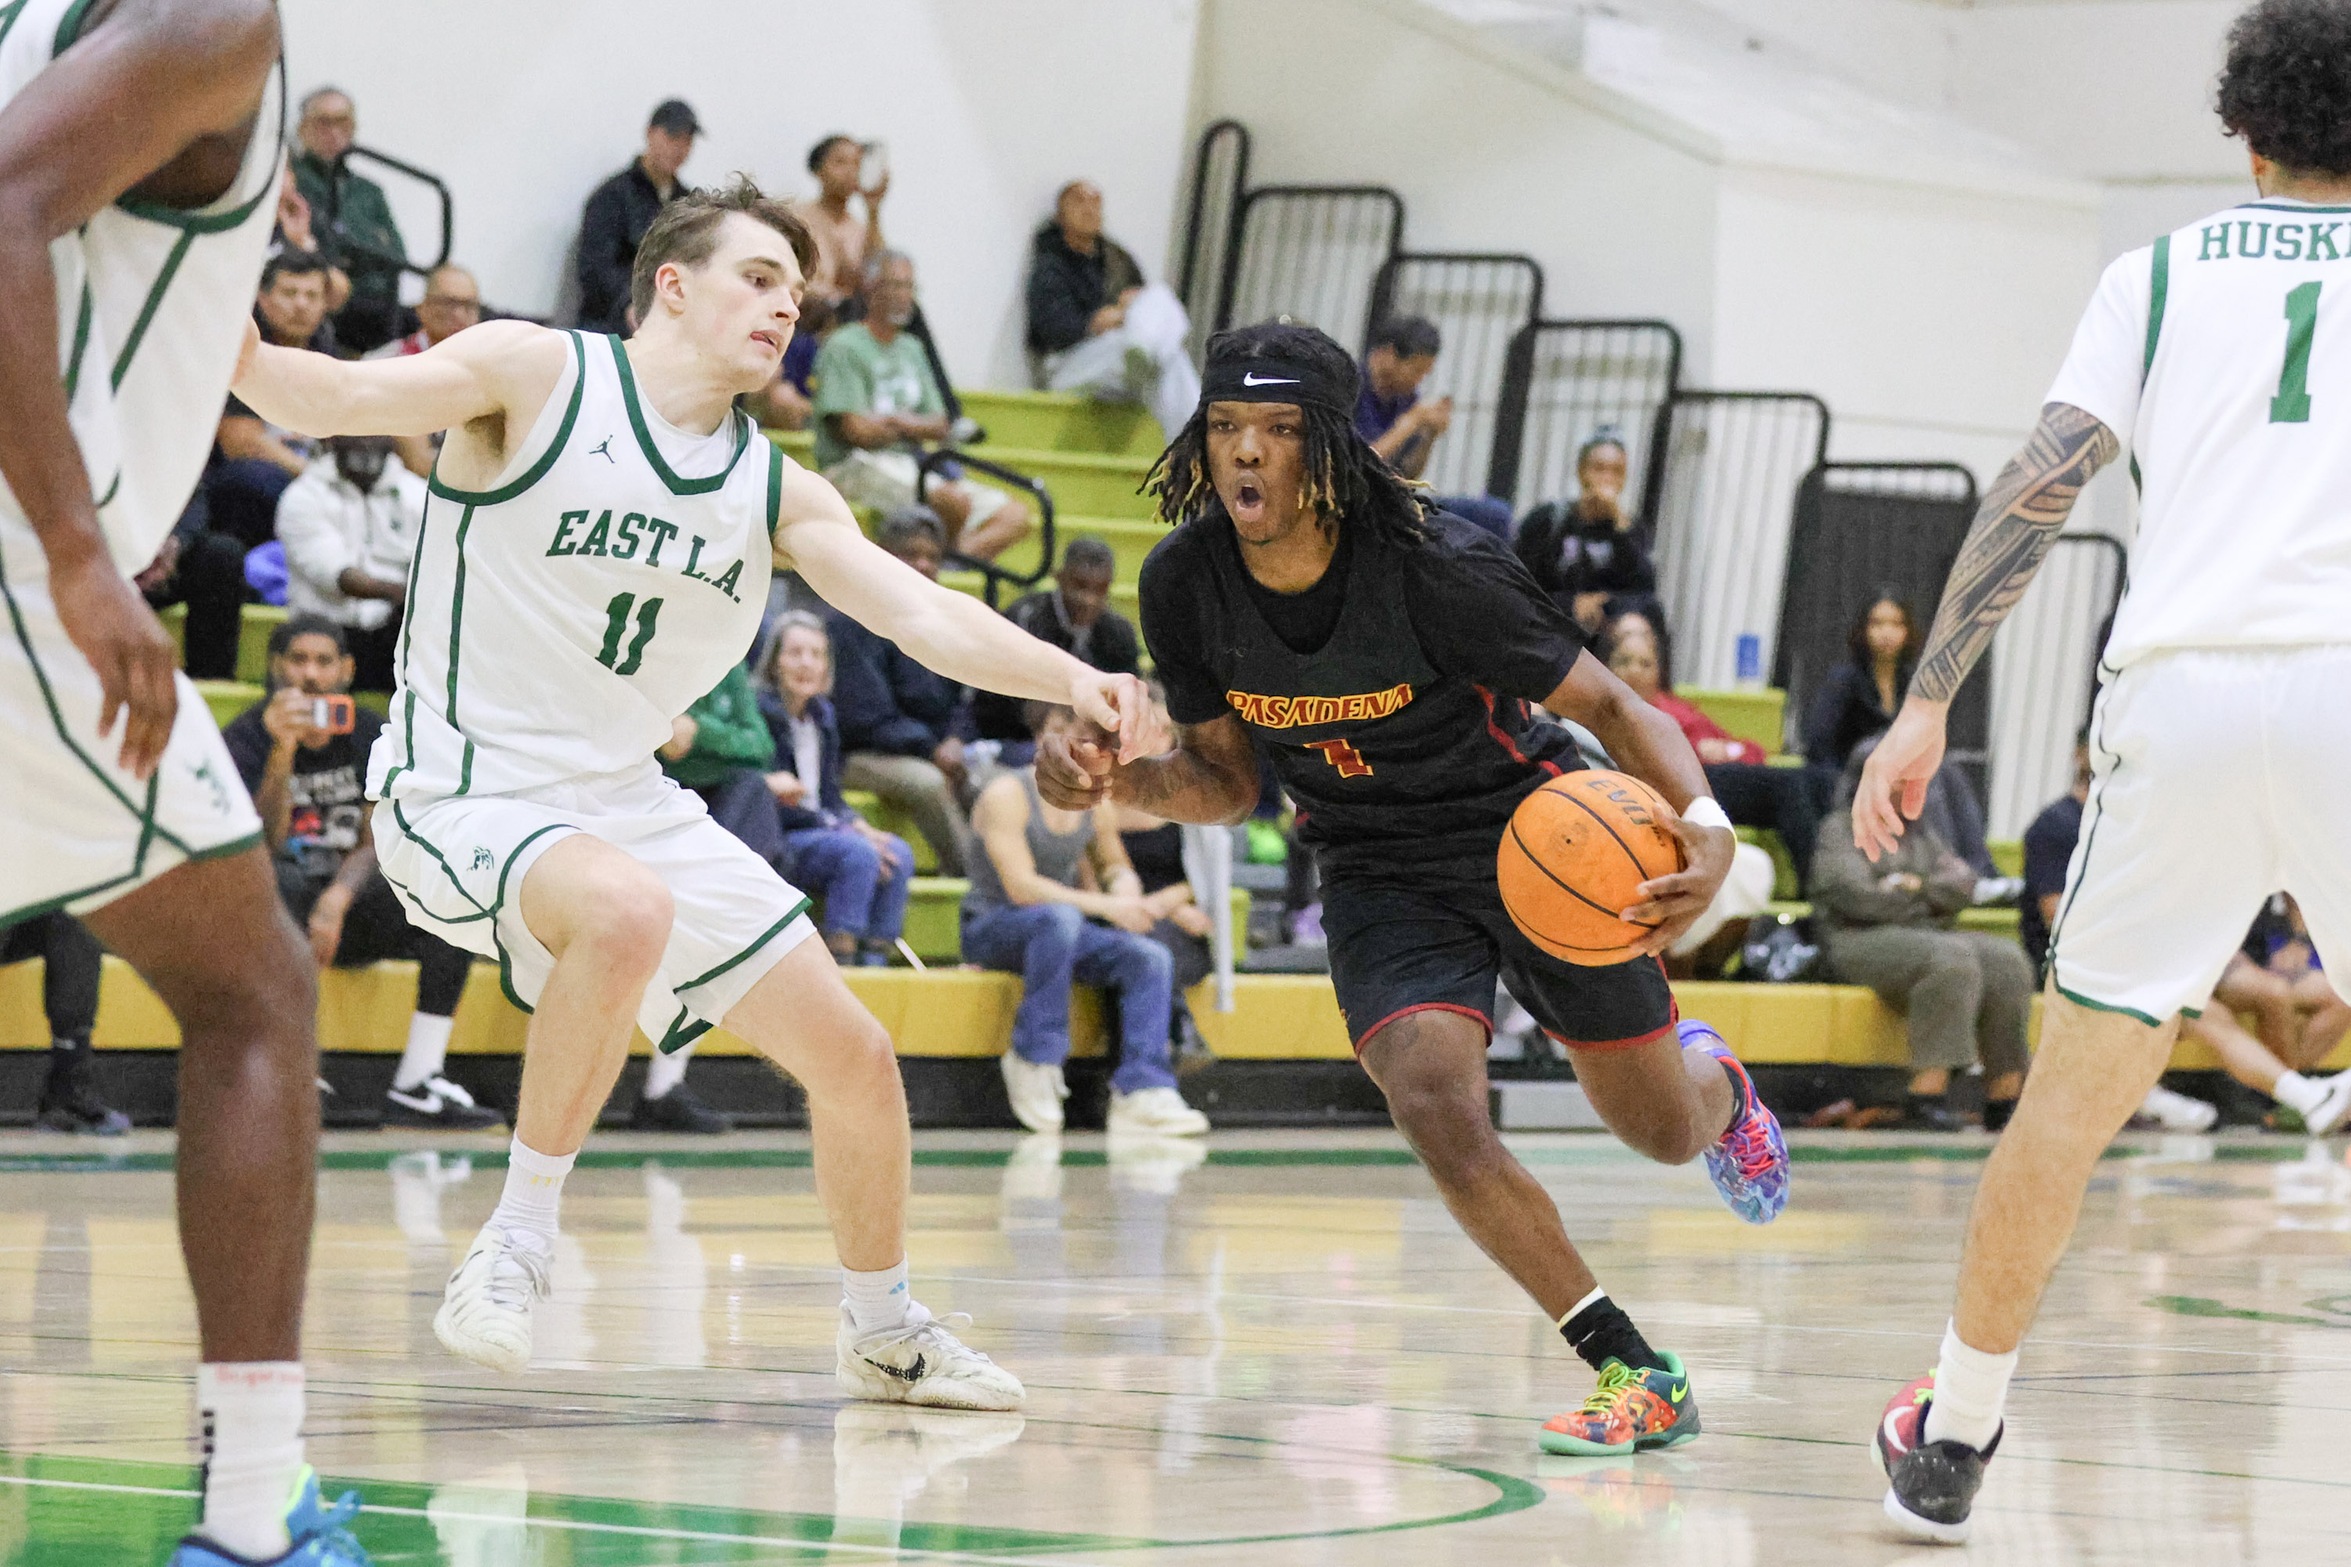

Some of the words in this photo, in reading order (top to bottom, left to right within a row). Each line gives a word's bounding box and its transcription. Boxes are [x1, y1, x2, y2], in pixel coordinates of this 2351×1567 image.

[2269, 281, 2322, 423] 1
[545, 509, 679, 568] EAST
[681, 535, 744, 604] L.A.
[595, 592, 664, 675] 11
[1226, 683, 1413, 729] PASADENA
